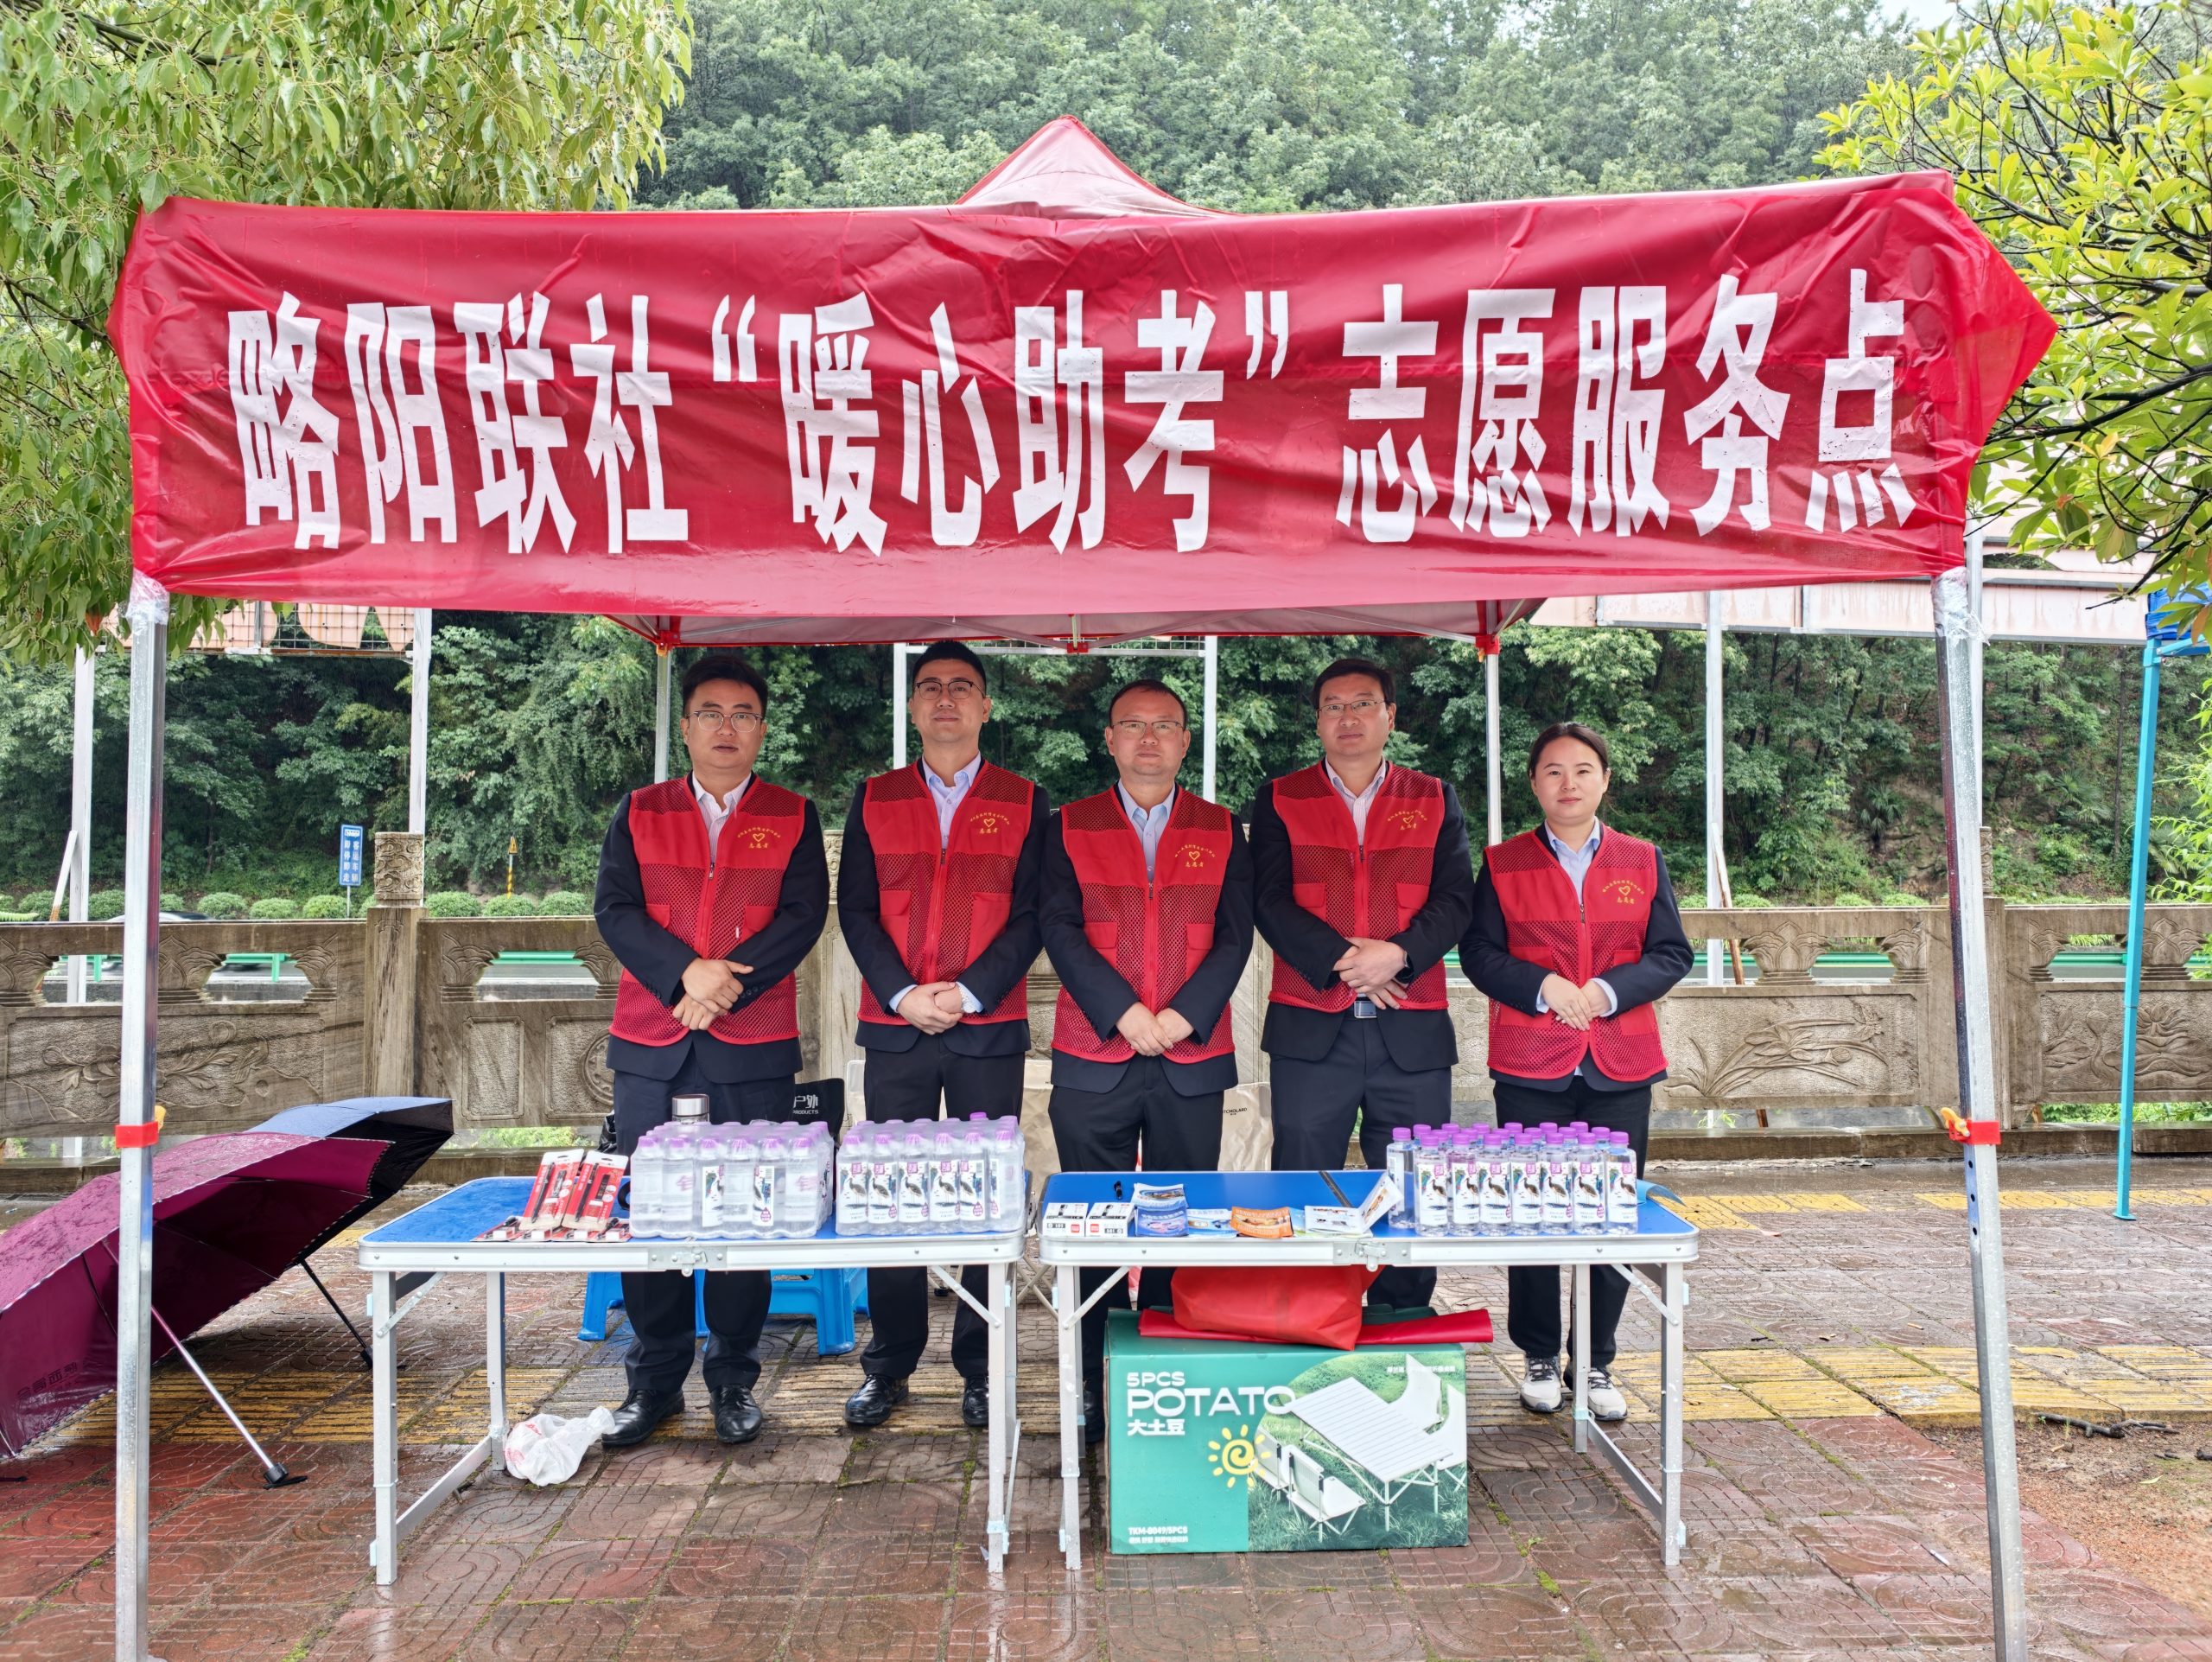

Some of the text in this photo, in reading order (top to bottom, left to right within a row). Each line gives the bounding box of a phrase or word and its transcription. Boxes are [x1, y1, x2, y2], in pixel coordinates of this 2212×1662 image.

[1126, 1371, 1185, 1387] 5PCS
[1127, 1385, 1296, 1417] POTATO
[1127, 1418, 1185, 1436] 大土豆
